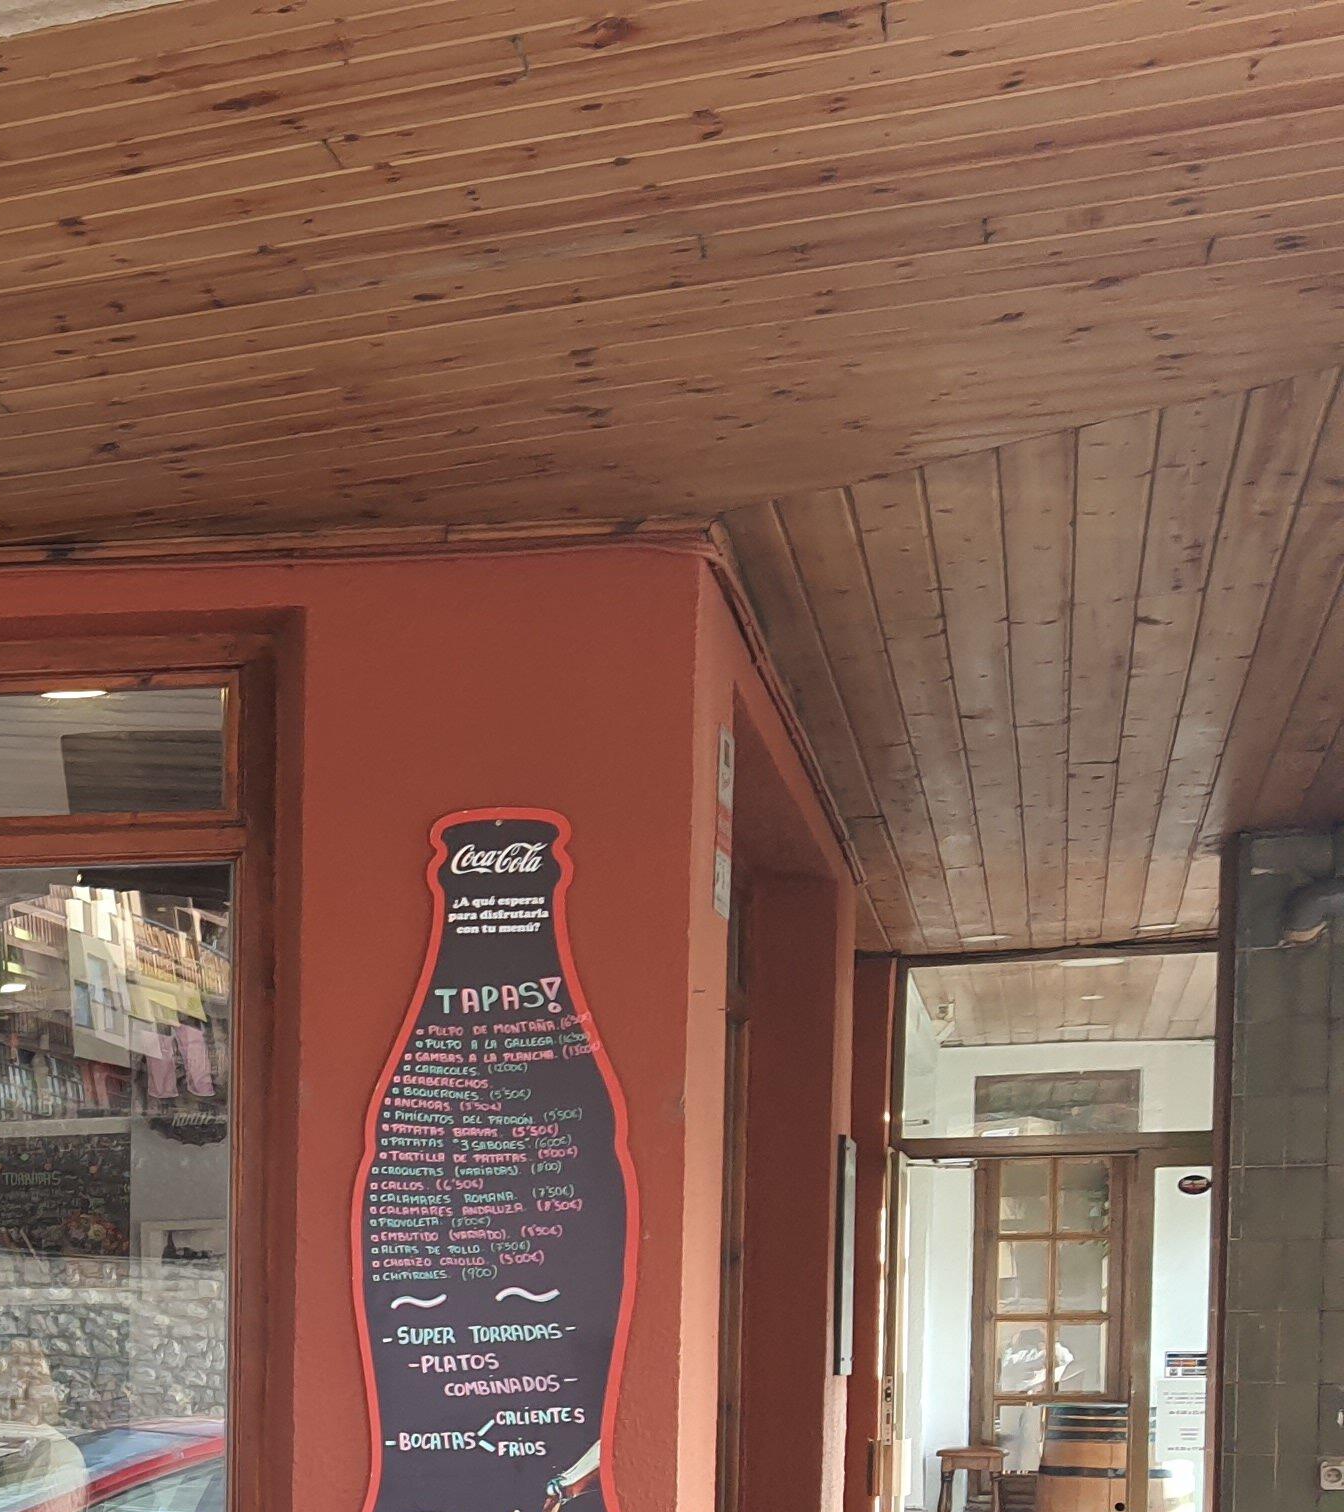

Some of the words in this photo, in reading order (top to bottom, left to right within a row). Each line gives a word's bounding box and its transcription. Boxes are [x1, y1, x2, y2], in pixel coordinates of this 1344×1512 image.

[451, 842, 548, 874] Coca-Cola
[472, 896, 495, 908] qué
[498, 897, 545, 907] esperas
[448, 911, 477, 922] para
[456, 926, 479, 934] con
[482, 924, 496, 933] tu
[428, 1025, 463, 1036] PULPO
[473, 1025, 488, 1035] DE
[426, 1039, 461, 1049] PULPO
[485, 1039, 497, 1049] LA
[415, 1053, 464, 1063] GAMBAS
[463, 1115, 482, 1125] DEL
[453, 1154, 467, 1163] DE
[381, 1166, 443, 1176] CROQUETAS
[380, 1194, 451, 1205] CALAMARES
[425, 1245, 440, 1255] DE
[398, 1326, 456, 1345] SUPER
[468, 1323, 563, 1344] TORRADAS
[399, 1431, 477, 1451] BOCATAS
